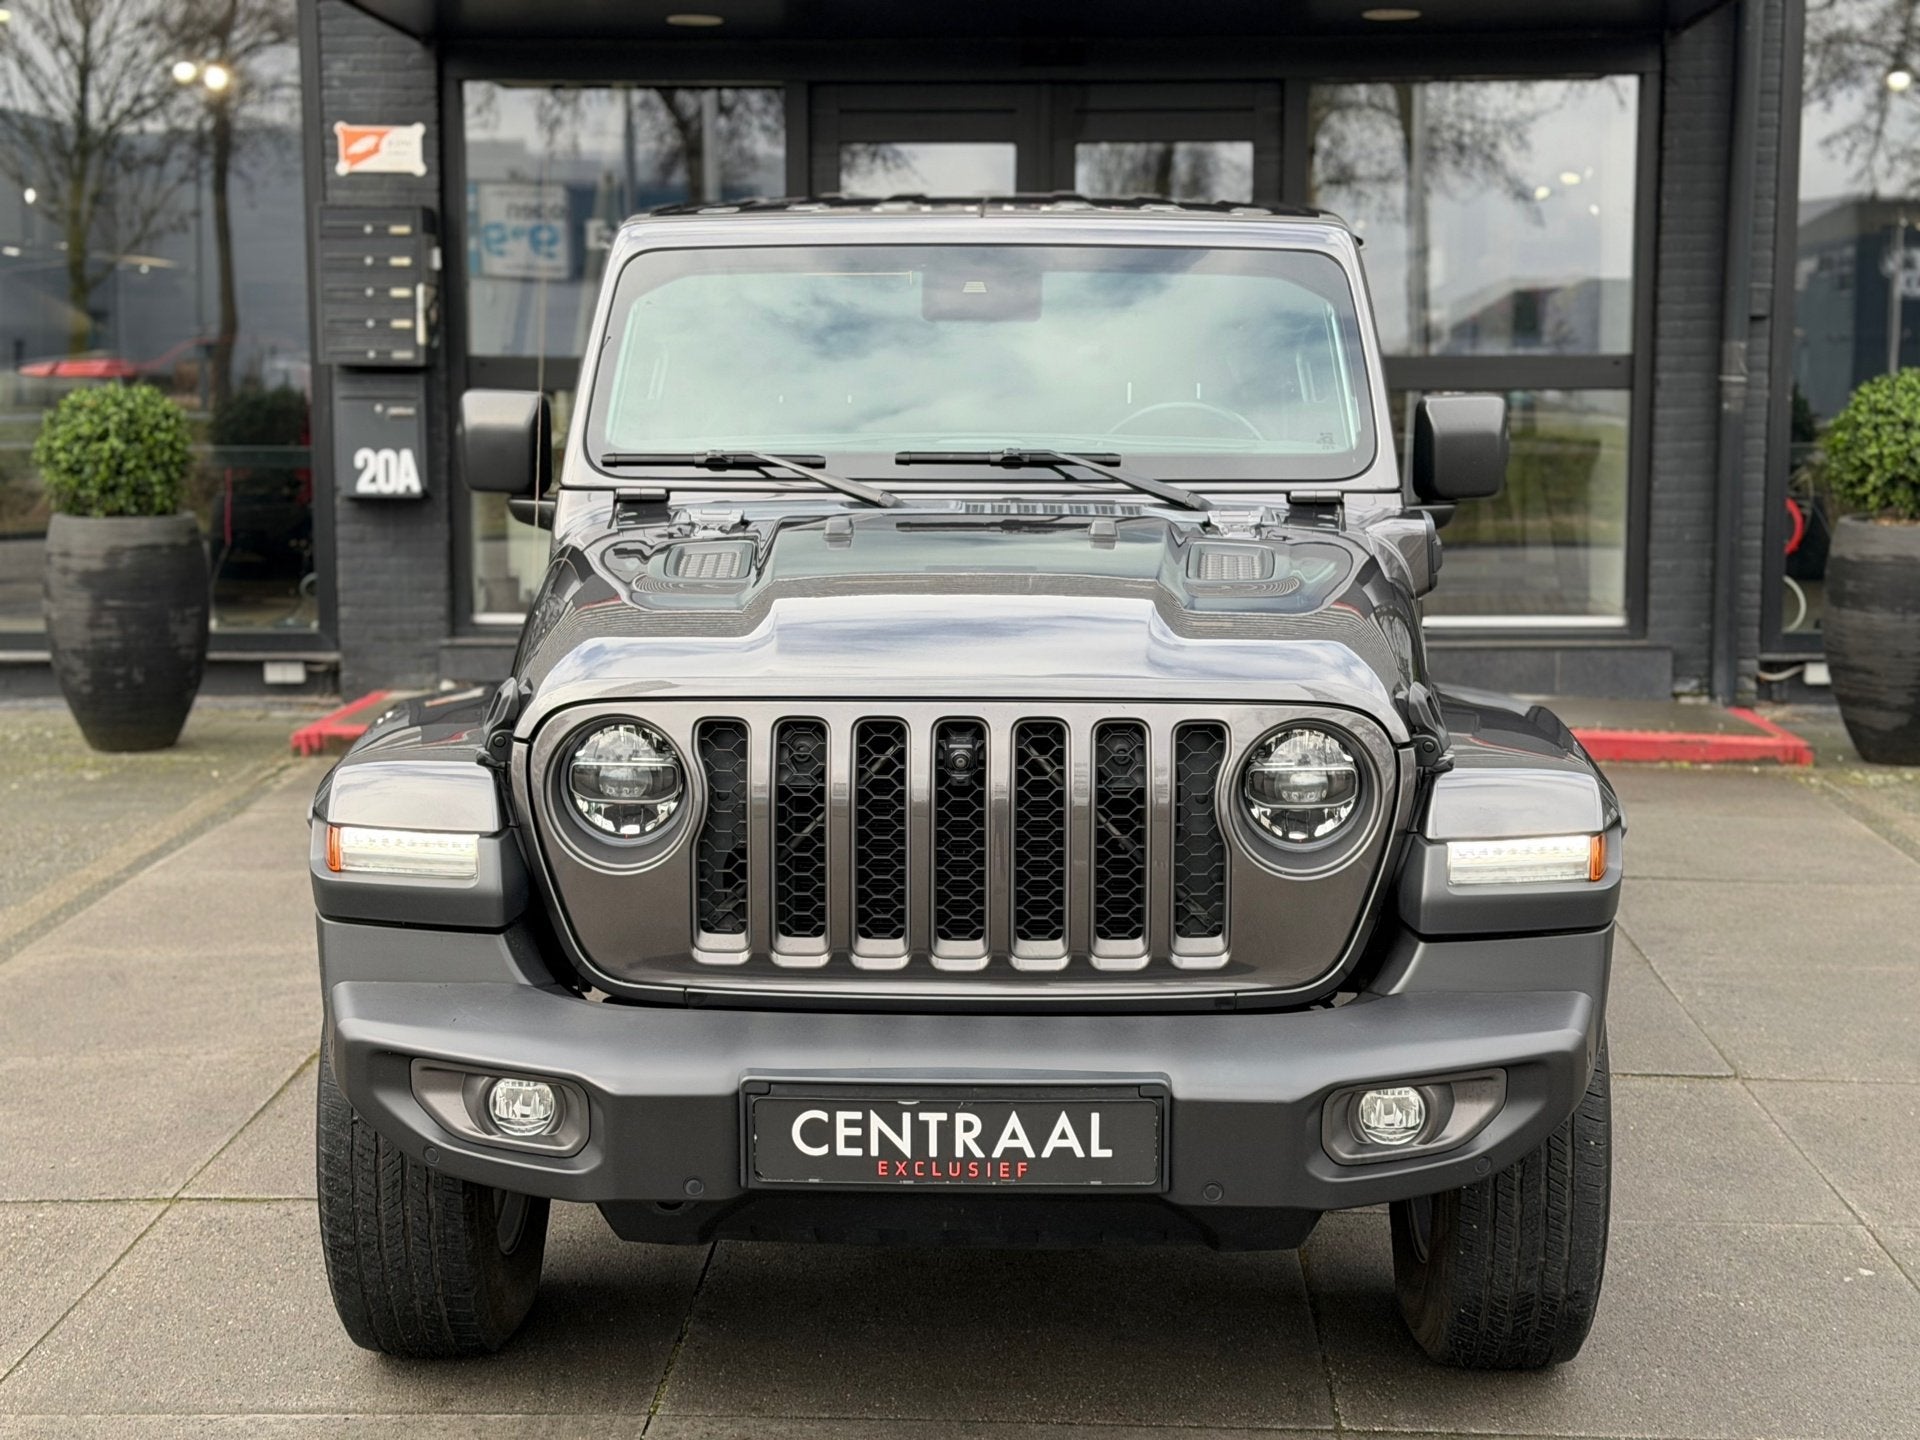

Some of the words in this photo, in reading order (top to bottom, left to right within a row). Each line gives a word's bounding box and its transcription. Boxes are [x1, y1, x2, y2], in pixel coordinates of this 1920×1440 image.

[353, 447, 422, 494] 20A
[791, 1109, 1113, 1160] CENTRAAL
[877, 1160, 1028, 1179] EXCLUSIEF
